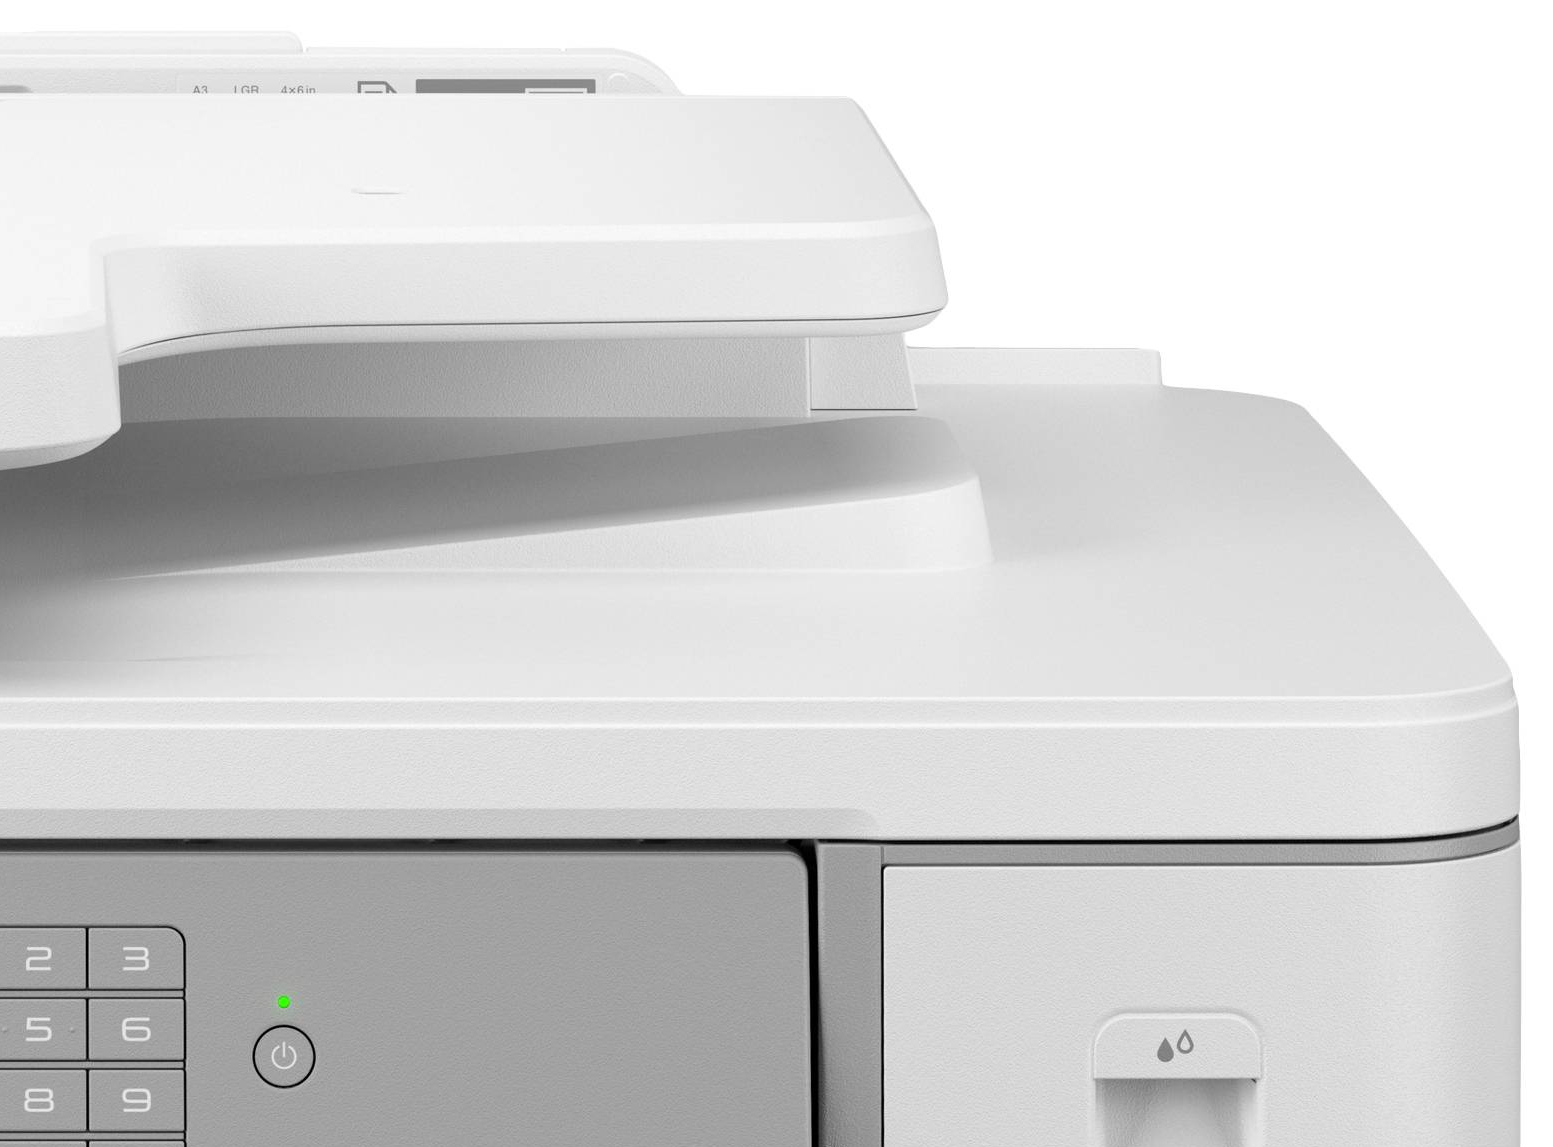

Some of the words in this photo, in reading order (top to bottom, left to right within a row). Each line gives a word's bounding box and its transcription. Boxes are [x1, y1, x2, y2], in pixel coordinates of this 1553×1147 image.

[25, 946, 52, 972] 2
[122, 946, 150, 972] 3
[25, 1017, 53, 1042] 5
[121, 1017, 152, 1042] 6
[23, 1087, 55, 1113] 8
[121, 1088, 152, 1113] 9
